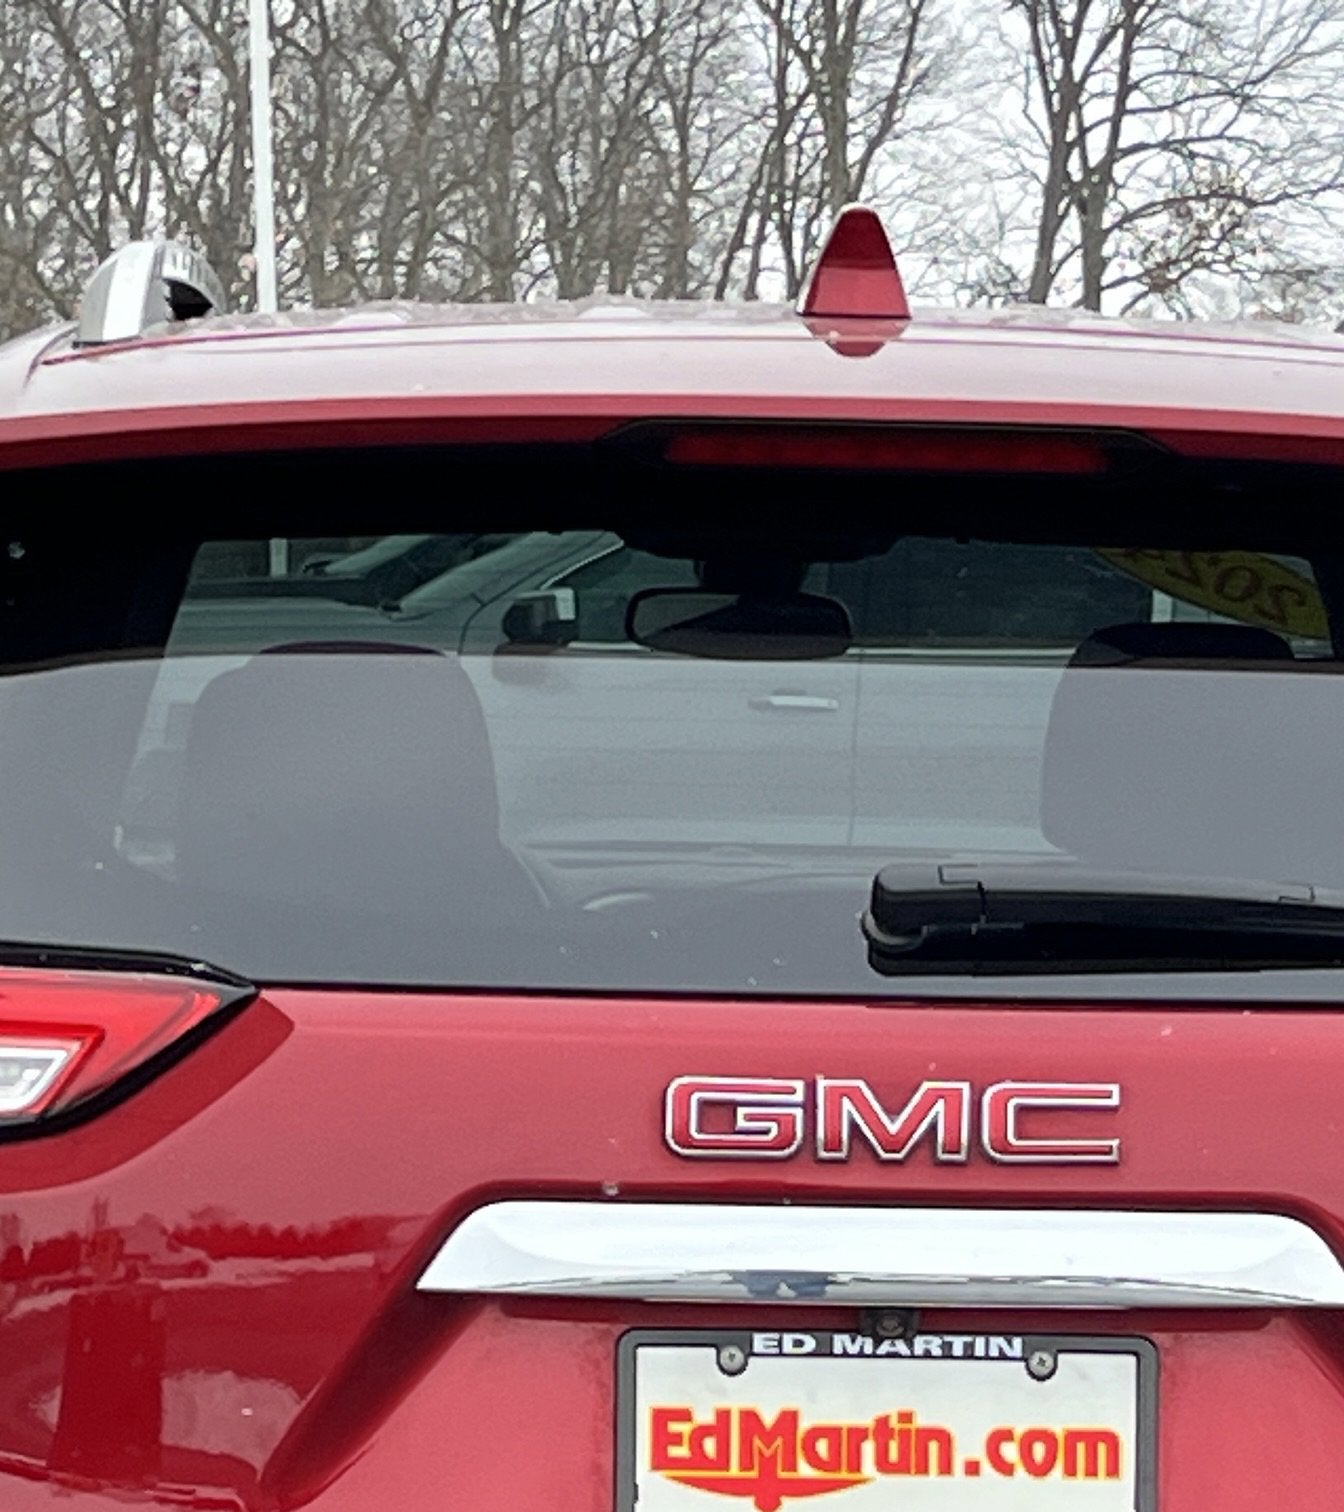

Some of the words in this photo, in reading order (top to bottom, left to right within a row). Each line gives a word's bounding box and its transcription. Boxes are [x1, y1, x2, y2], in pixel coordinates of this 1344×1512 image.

[664, 1074, 1121, 1163] GMC
[751, 1332, 816, 1356] ED
[832, 1334, 1023, 1358] MARTIN
[648, 1406, 1121, 1481] EdMartin.com
